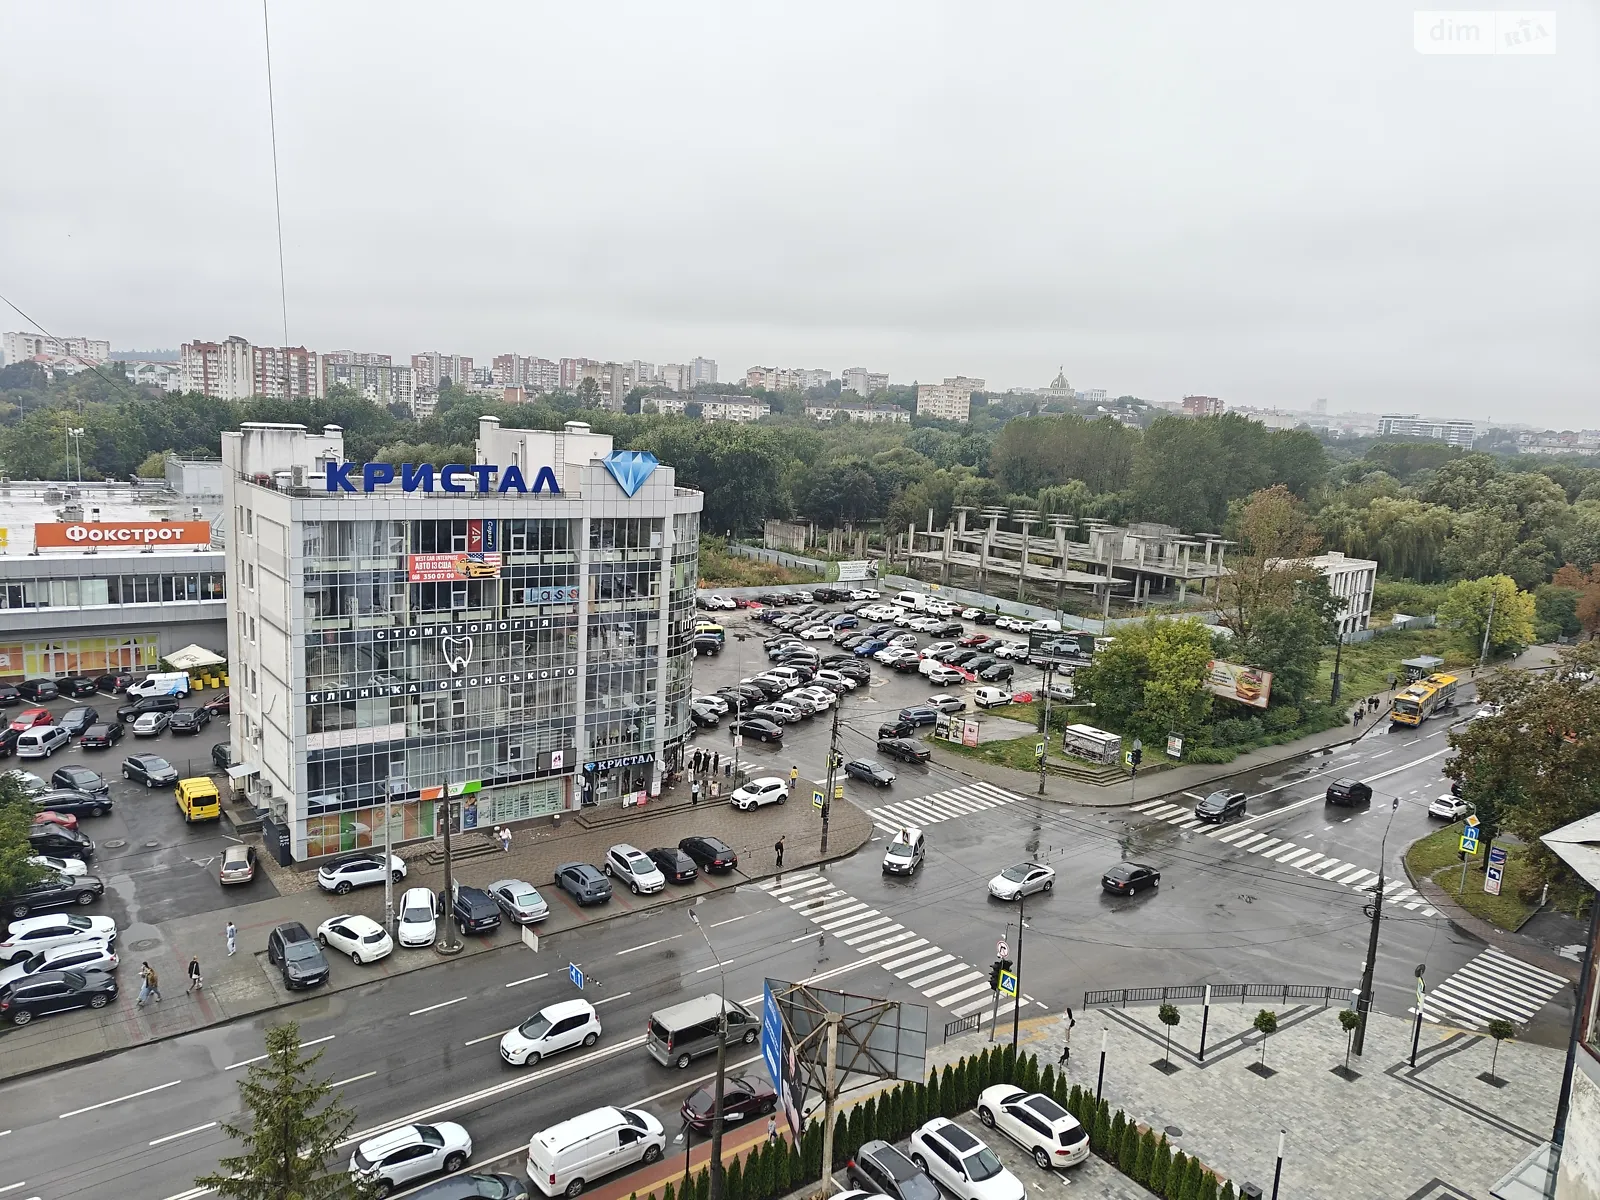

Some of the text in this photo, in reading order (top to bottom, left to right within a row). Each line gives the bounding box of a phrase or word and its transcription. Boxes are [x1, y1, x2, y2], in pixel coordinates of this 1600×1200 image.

[327, 462, 560, 493] КРИСТАЛ
[65, 525, 184, 542] Фокстрот
[438, 561, 451, 569] США
[376, 619, 549, 640] СТОМАТОЛОГІЯ
[310, 668, 575, 703] КЛІНІКА ОКОНСЬКОГО
[597, 753, 655, 771] КРИСТАЛ
